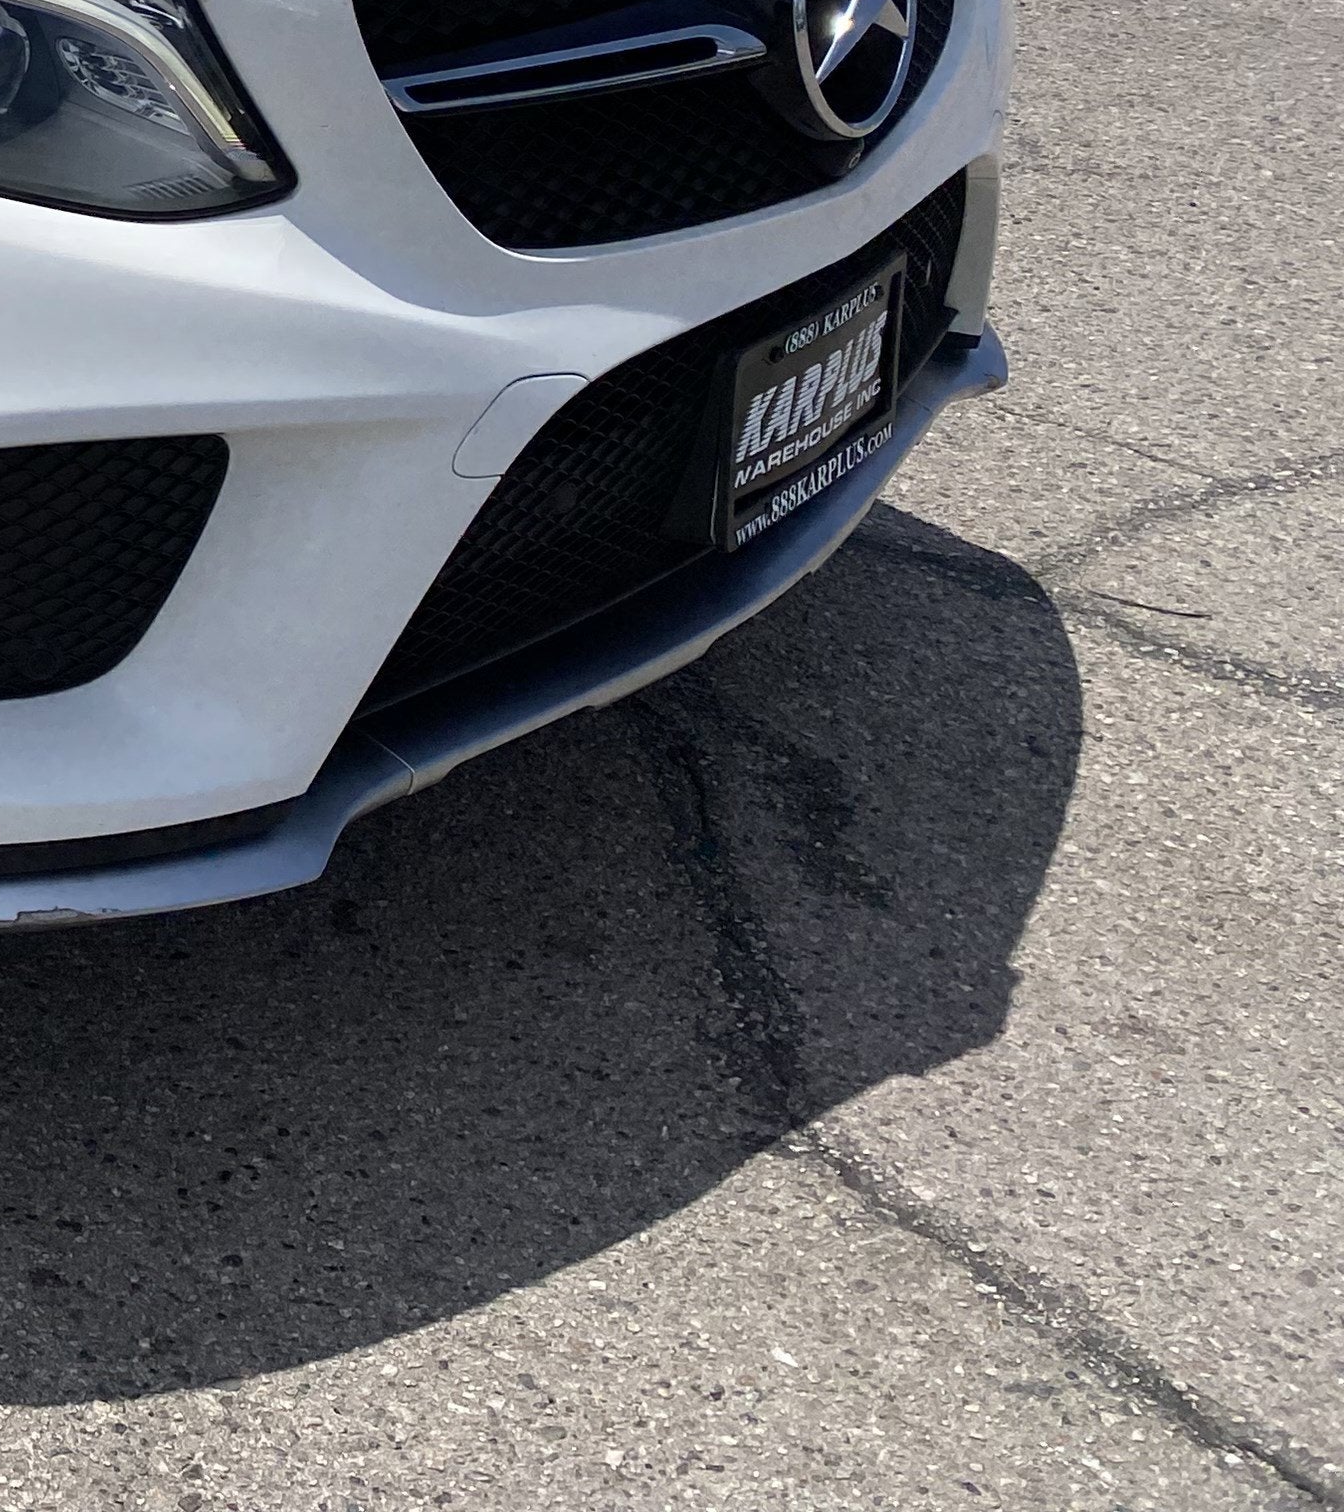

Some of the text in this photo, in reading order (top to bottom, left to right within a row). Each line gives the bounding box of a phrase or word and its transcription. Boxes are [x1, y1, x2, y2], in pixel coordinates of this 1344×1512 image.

[784, 281, 878, 355] (888) KARPLUS
[734, 378, 882, 489] WAREHOUSE INC
[735, 310, 888, 464] KARPLUS
